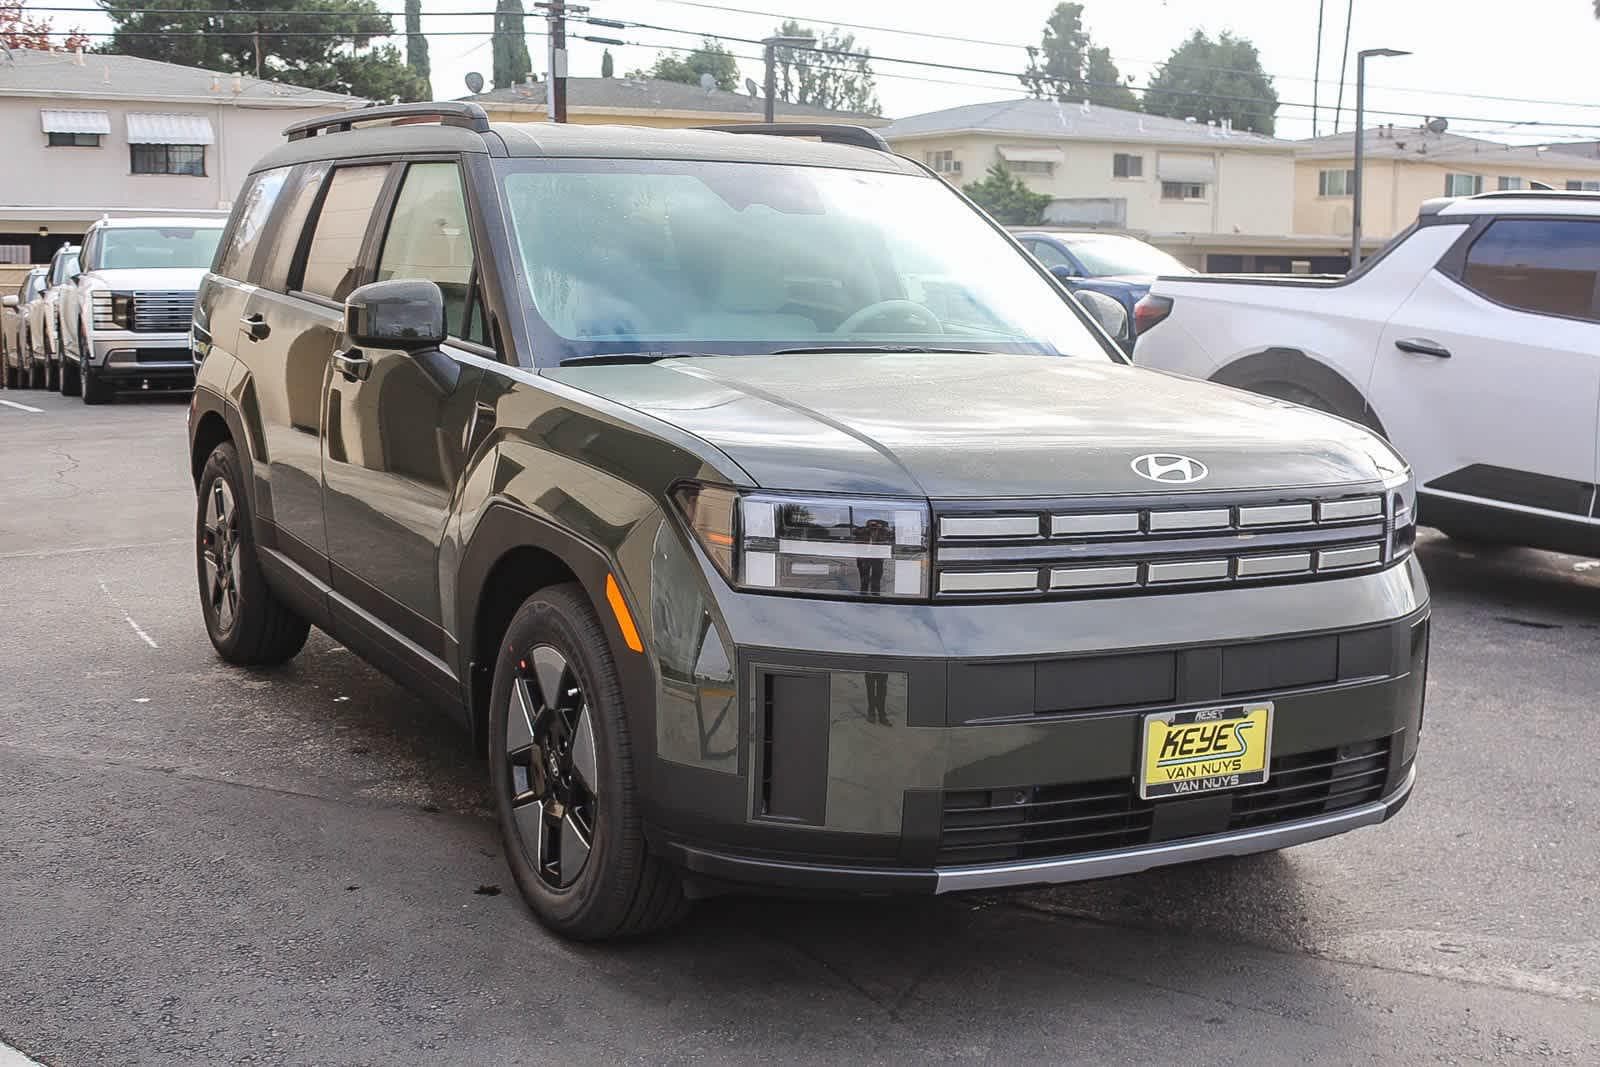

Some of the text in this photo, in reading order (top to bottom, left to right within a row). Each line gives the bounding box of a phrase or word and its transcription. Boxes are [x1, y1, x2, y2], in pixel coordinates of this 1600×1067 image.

[1159, 721, 1254, 760] KEYES
[1166, 759, 1242, 780] VAN NUYS
[1173, 775, 1239, 793] VAN NUYS
